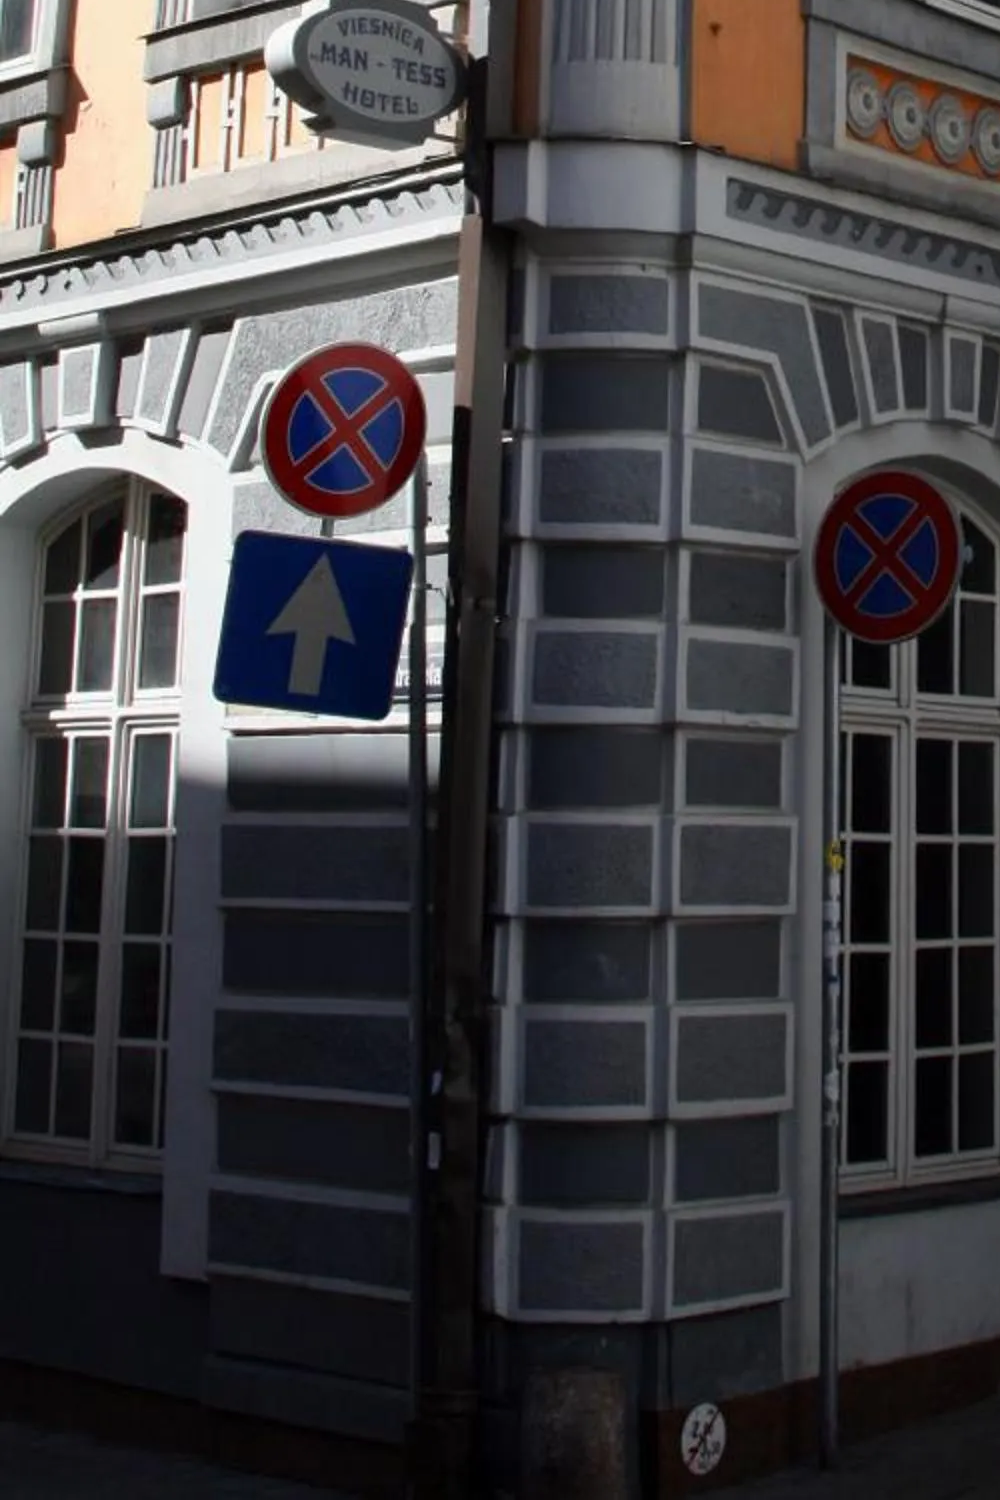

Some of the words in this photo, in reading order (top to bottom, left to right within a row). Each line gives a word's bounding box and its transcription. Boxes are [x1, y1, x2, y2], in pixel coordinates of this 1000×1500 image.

[321, 42, 368, 71] MAN
[393, 58, 446, 89] TESS
[342, 82, 419, 115] HOTEL
